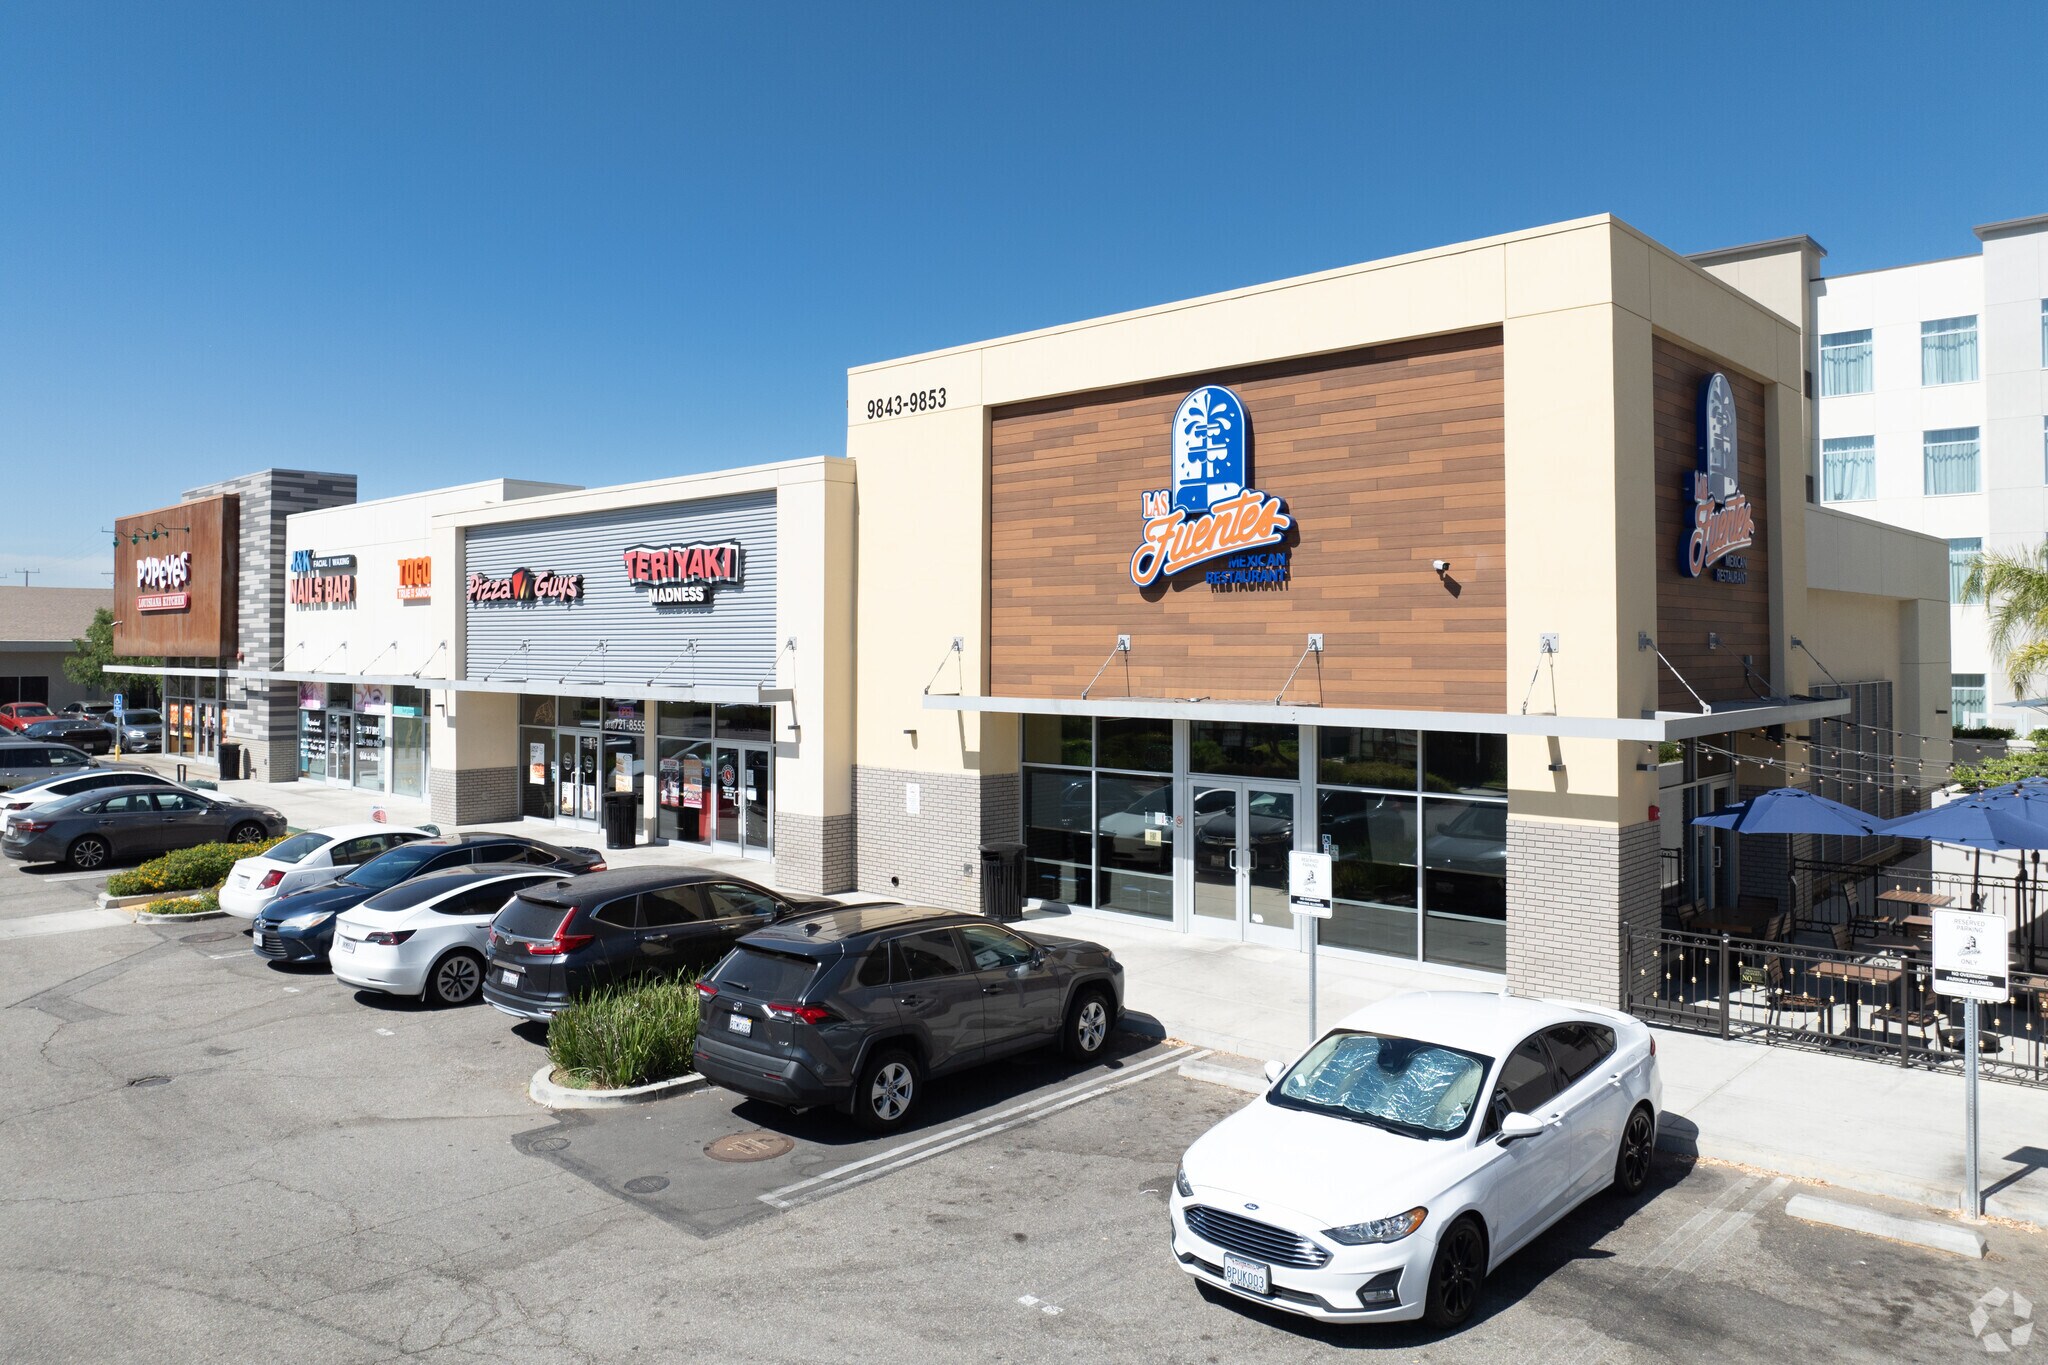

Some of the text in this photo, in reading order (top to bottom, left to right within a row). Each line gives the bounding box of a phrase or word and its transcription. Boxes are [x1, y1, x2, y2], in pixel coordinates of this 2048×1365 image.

[867, 387, 947, 420] 9843-9853
[1143, 491, 1169, 518] LAS
[1131, 490, 1290, 586] Fuentes
[291, 550, 312, 573] J&K
[313, 559, 328, 568] FACIAL
[624, 546, 732, 581] TERIYAKI
[1228, 552, 1287, 569] MEXICAN
[1724, 553, 1748, 569] MEXICAN
[1205, 569, 1286, 585] RESTAURANT
[1716, 568, 1748, 584] RESTAURANT
[290, 574, 351, 605] NAILS BAR
[467, 571, 578, 602] Pizza Guys
[648, 586, 705, 604] MADNESS
[1953, 918, 1985, 927] RESERVED
[1956, 925, 1983, 933] PARKING
[1960, 958, 1978, 966] ONLY
[1742, 974, 1753, 982] NO
[1946, 976, 1994, 987] PARKING ALLOWED
[1959, 972, 1989, 980] OVERNIGHT
[1226, 1265, 1264, 1289] 8PUK003
